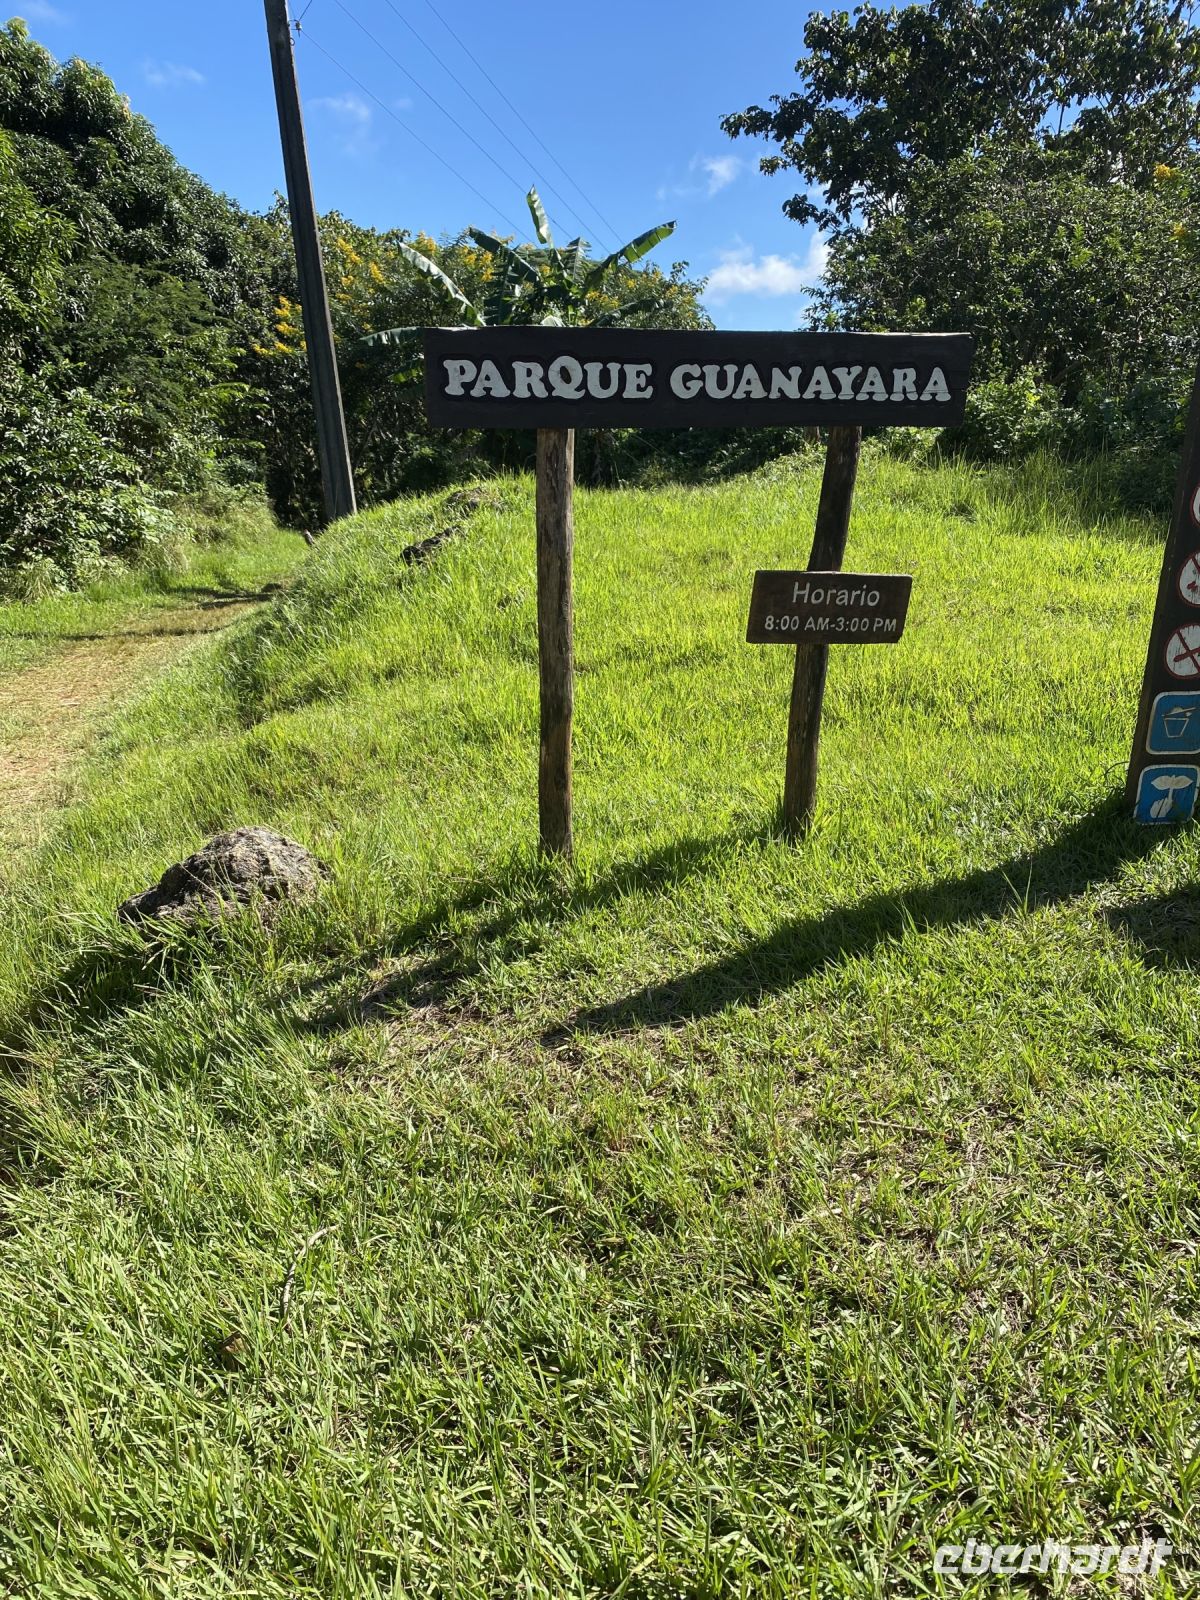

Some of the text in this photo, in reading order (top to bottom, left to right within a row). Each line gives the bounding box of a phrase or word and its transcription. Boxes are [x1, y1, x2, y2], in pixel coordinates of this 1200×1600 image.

[443, 355, 952, 402] PARQUE GUANAYARA
[792, 582, 880, 606] Horario
[764, 615, 799, 631] 8:00
[875, 617, 897, 632] PM
